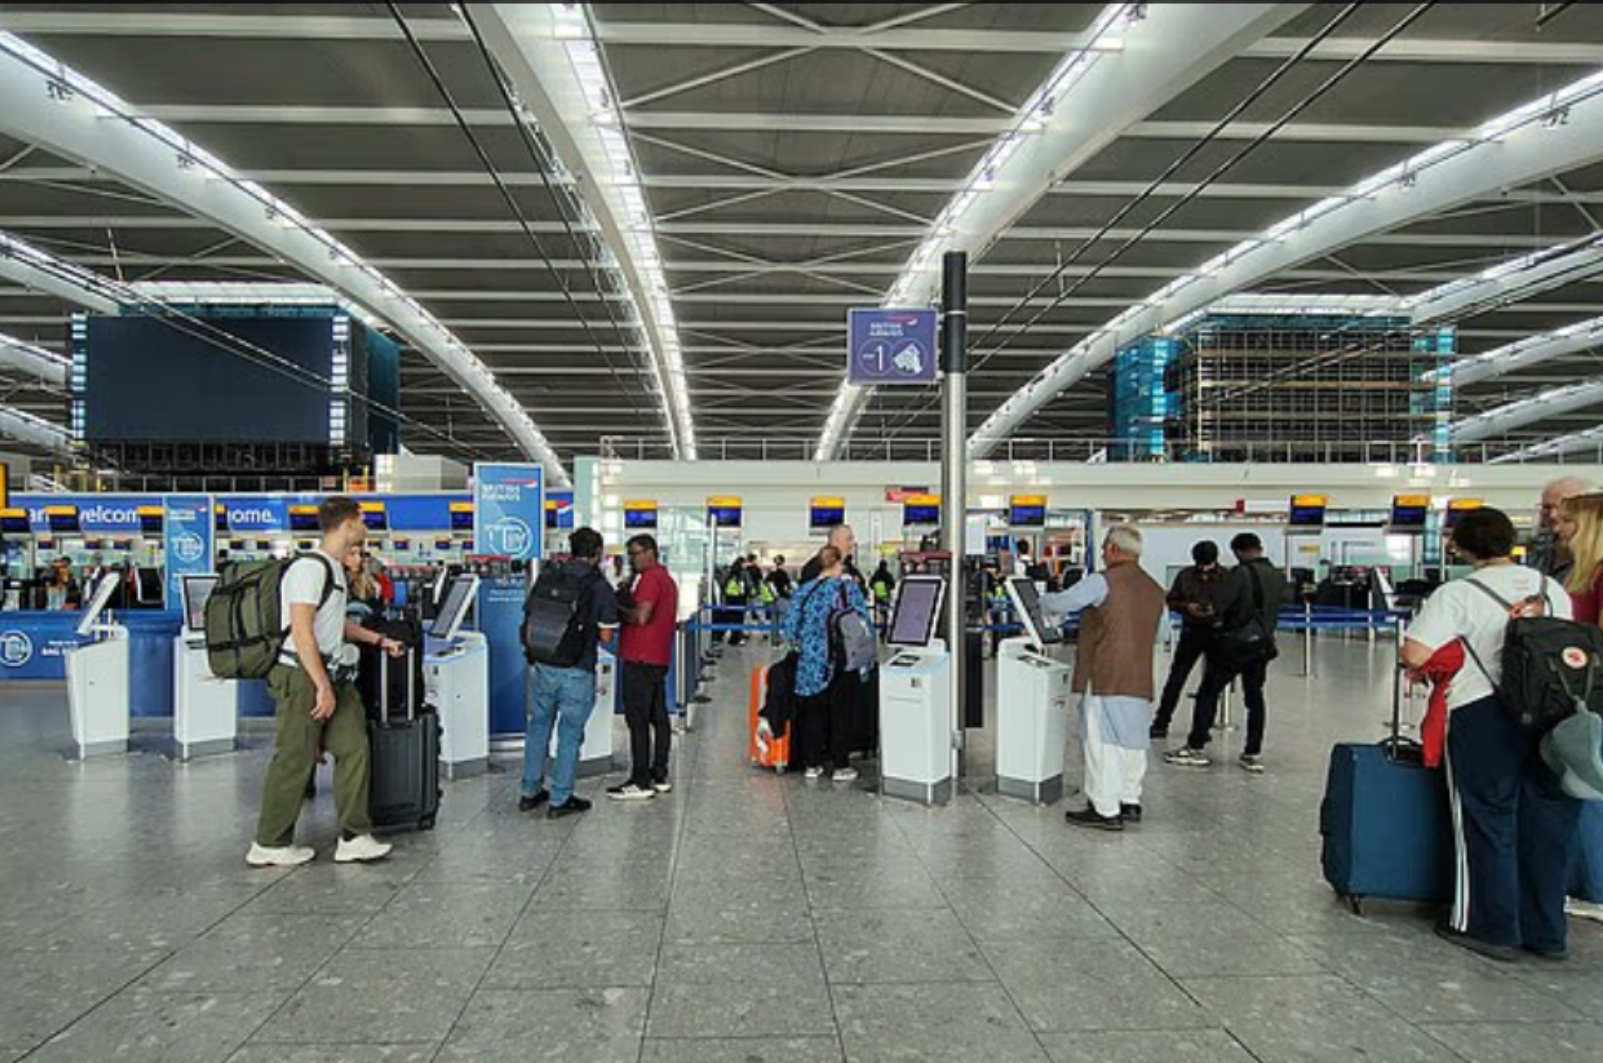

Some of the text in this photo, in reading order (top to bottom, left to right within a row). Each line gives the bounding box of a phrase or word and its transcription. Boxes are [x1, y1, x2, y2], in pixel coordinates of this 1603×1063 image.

[29, 504, 278, 524] an elcom ome.
